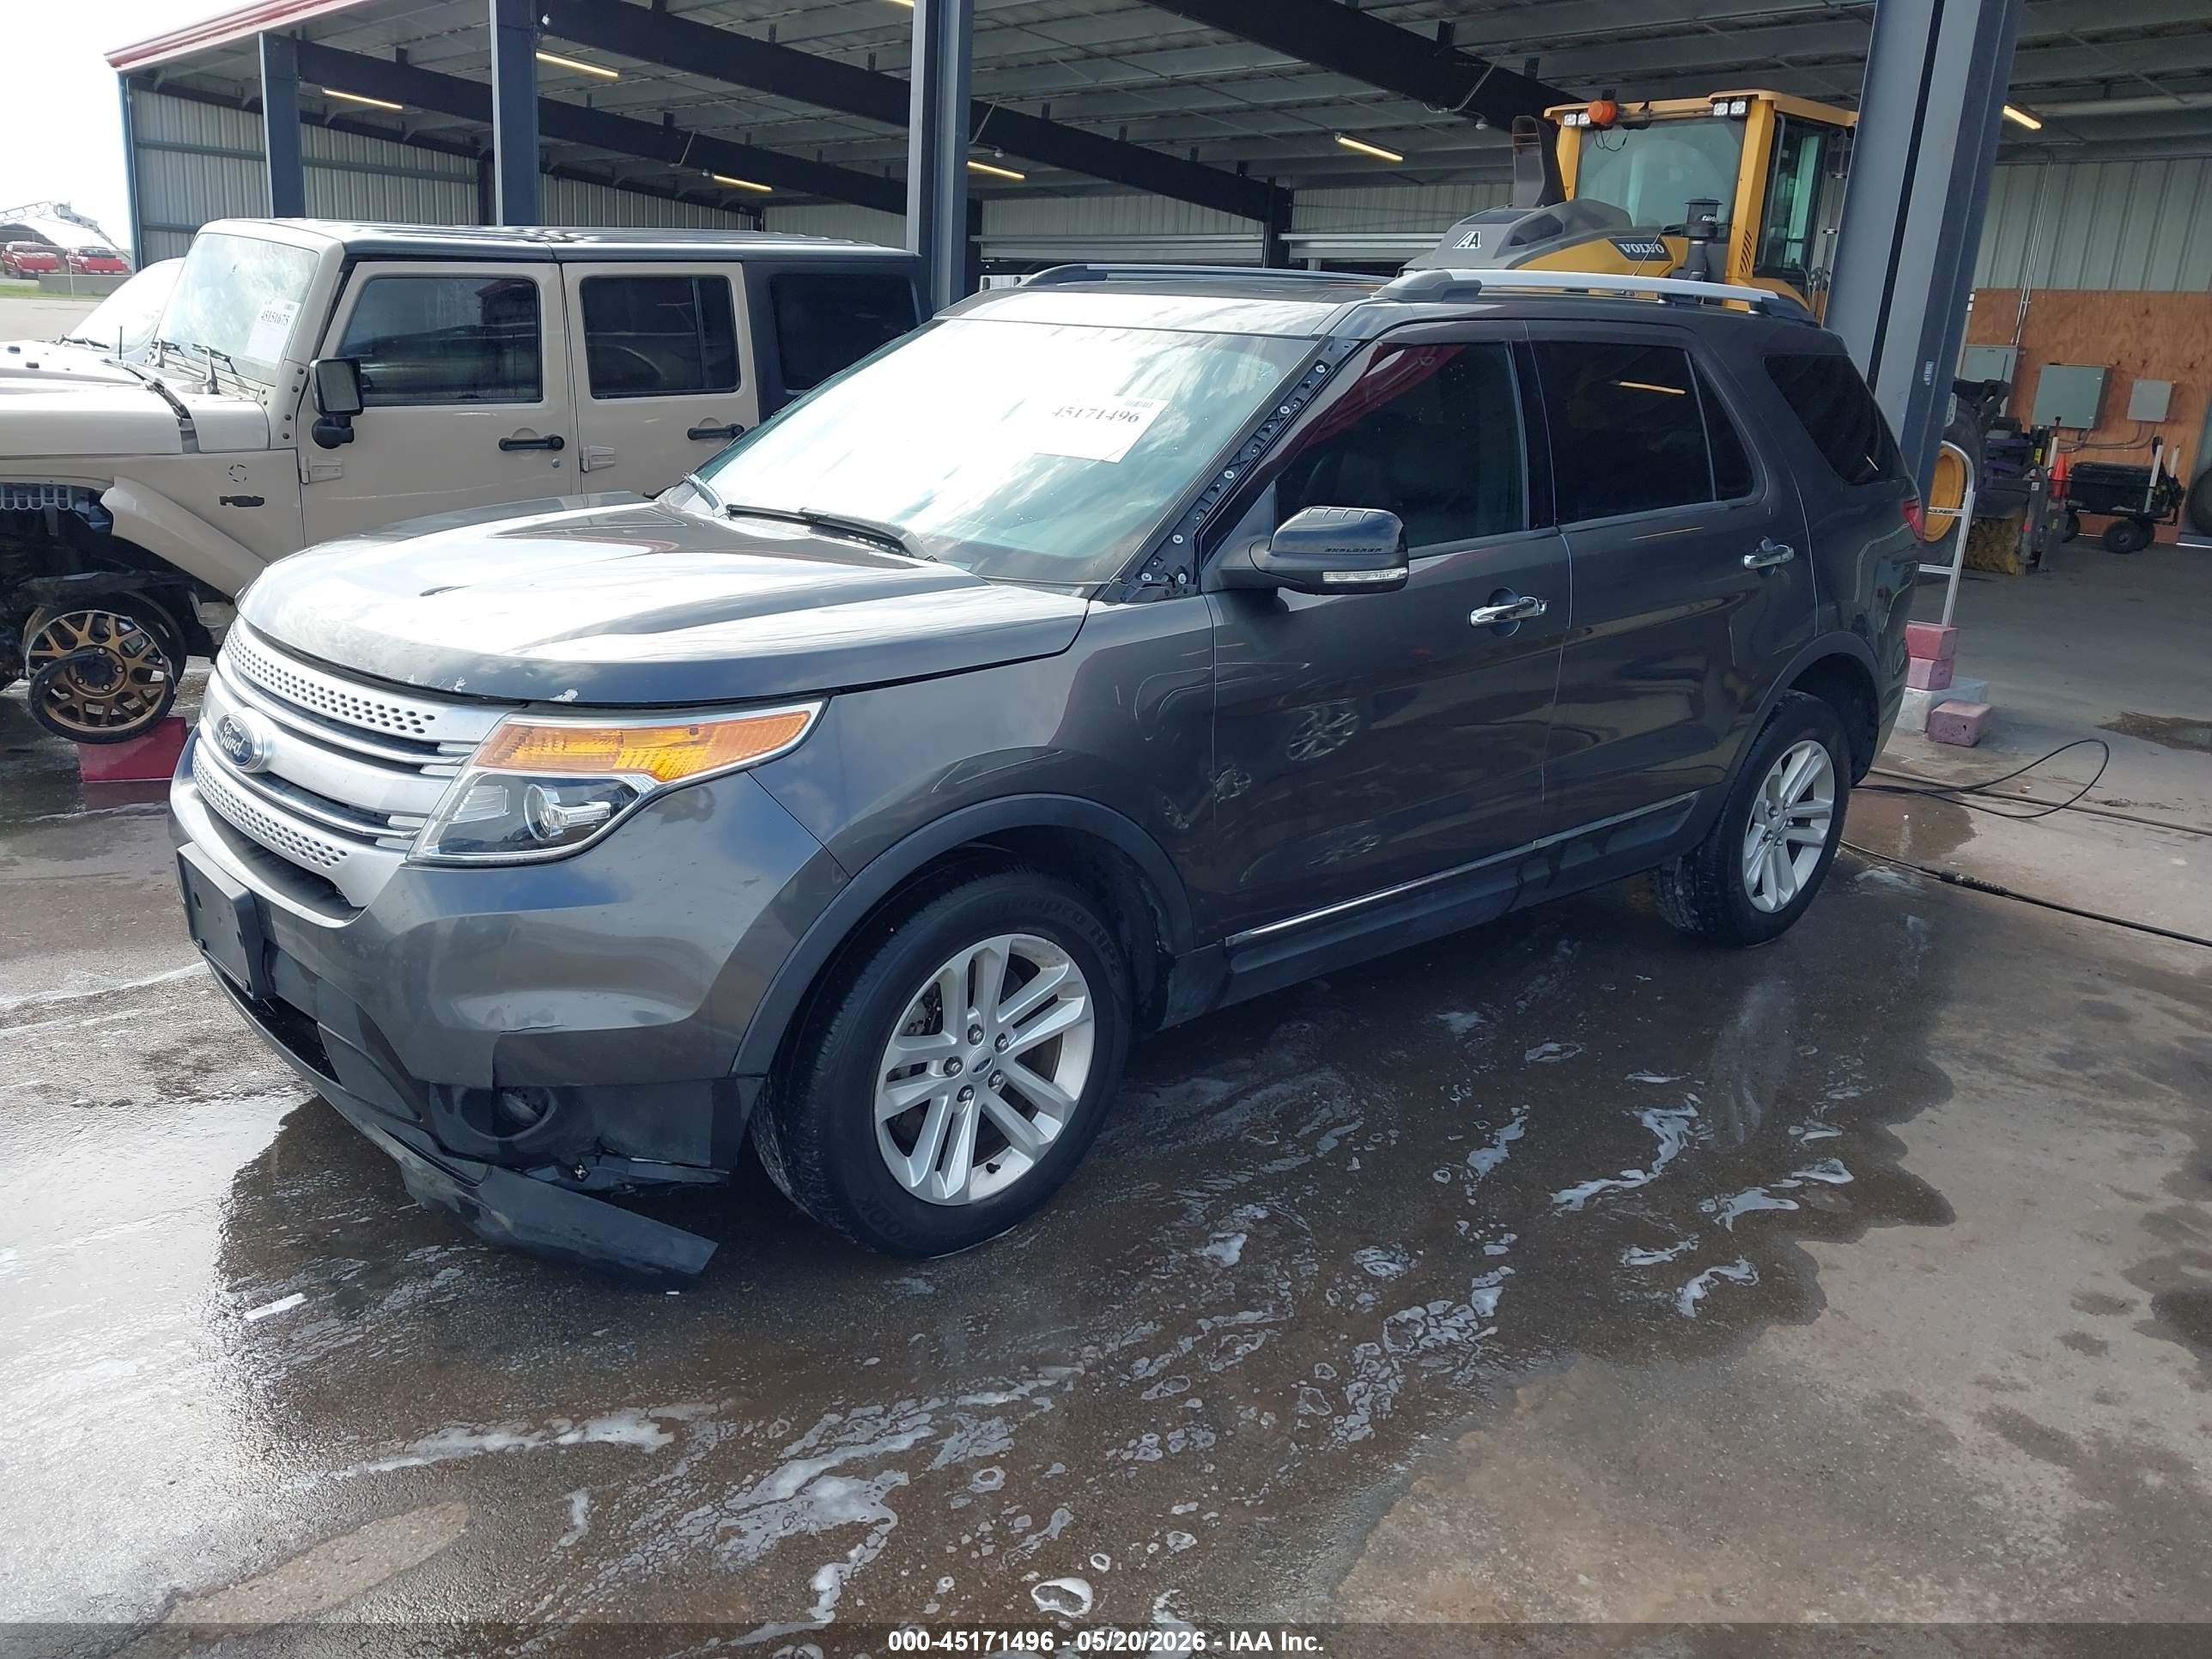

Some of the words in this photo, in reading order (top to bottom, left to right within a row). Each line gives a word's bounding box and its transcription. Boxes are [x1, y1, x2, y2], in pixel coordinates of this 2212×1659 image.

[1618, 243, 1665, 254] VOLVO
[1051, 406, 1139, 422] 45171496
[220, 720, 246, 757] Ford
